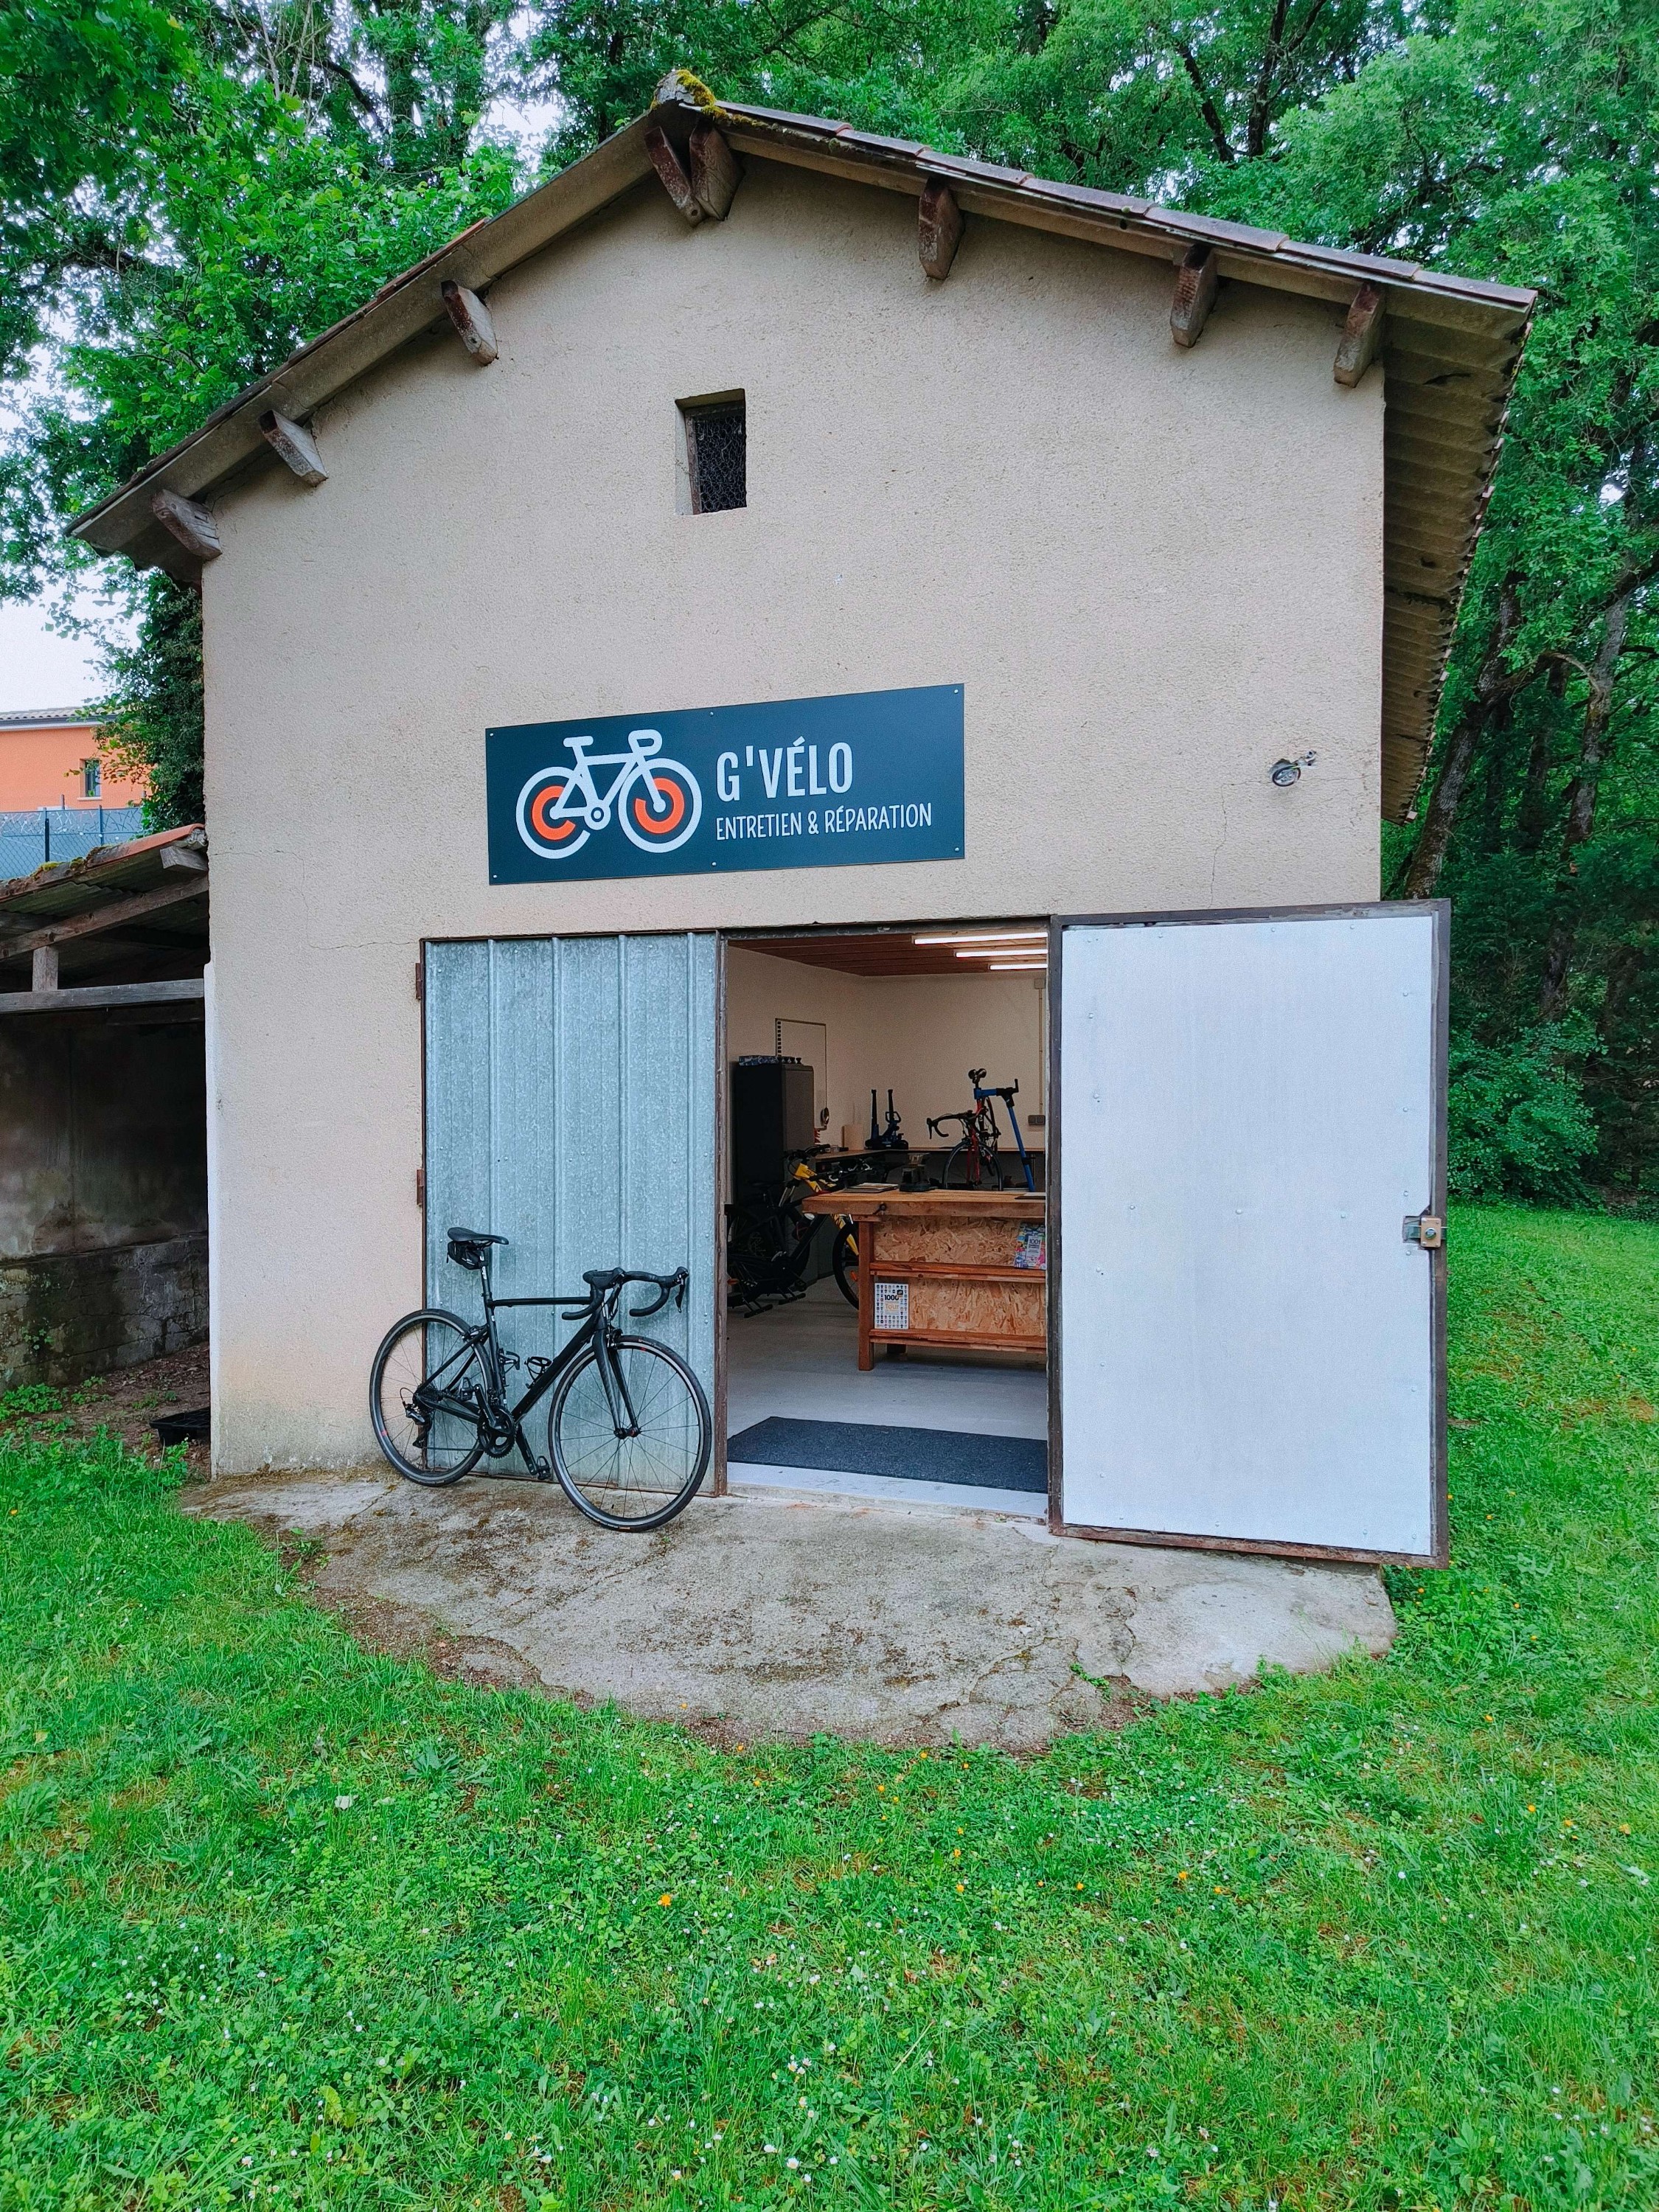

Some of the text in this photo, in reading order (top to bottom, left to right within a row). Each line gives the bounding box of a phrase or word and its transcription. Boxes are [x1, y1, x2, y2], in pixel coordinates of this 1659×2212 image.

[716, 736, 854, 802] G'VÉLO
[716, 802, 931, 841] ENTRETIEN & RÉPARATION
